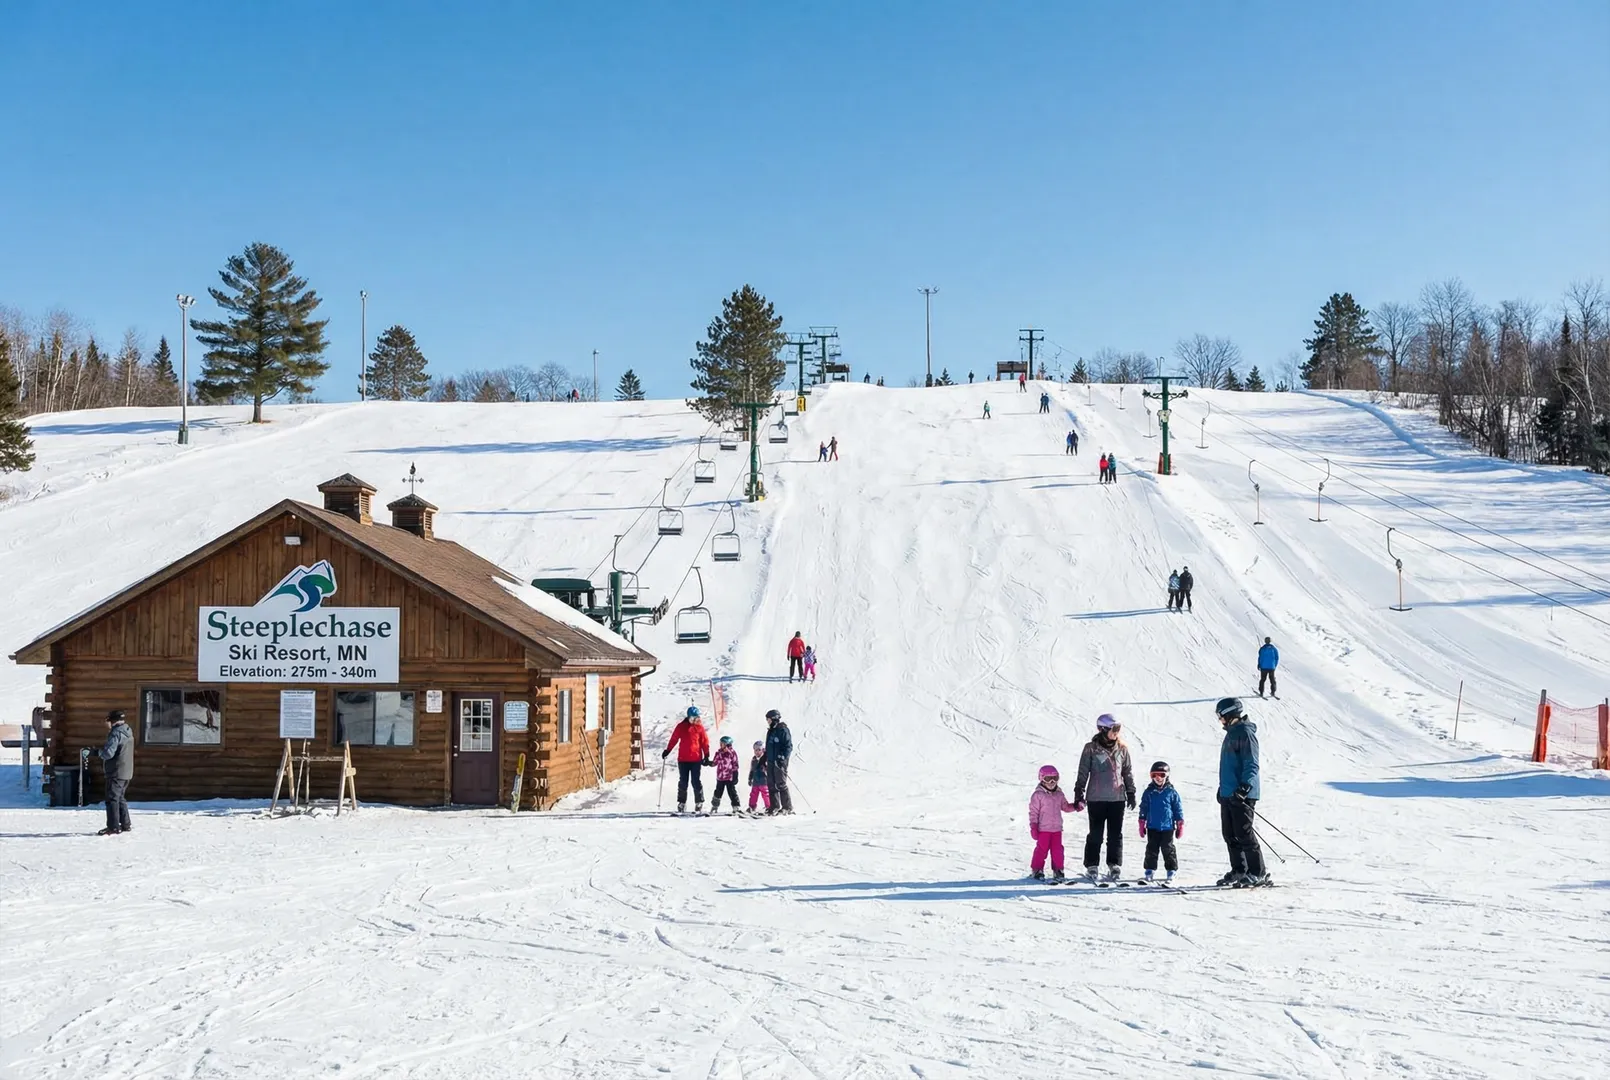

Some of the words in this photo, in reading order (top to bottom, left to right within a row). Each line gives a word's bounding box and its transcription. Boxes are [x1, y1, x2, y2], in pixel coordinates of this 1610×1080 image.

[206, 610, 392, 645] Steeplechase
[228, 644, 258, 661] Ski
[264, 644, 331, 664] Resort,
[337, 644, 368, 661] MN
[219, 665, 287, 678] Elevation:
[290, 665, 328, 678] 275m
[340, 665, 377, 679] 340m
